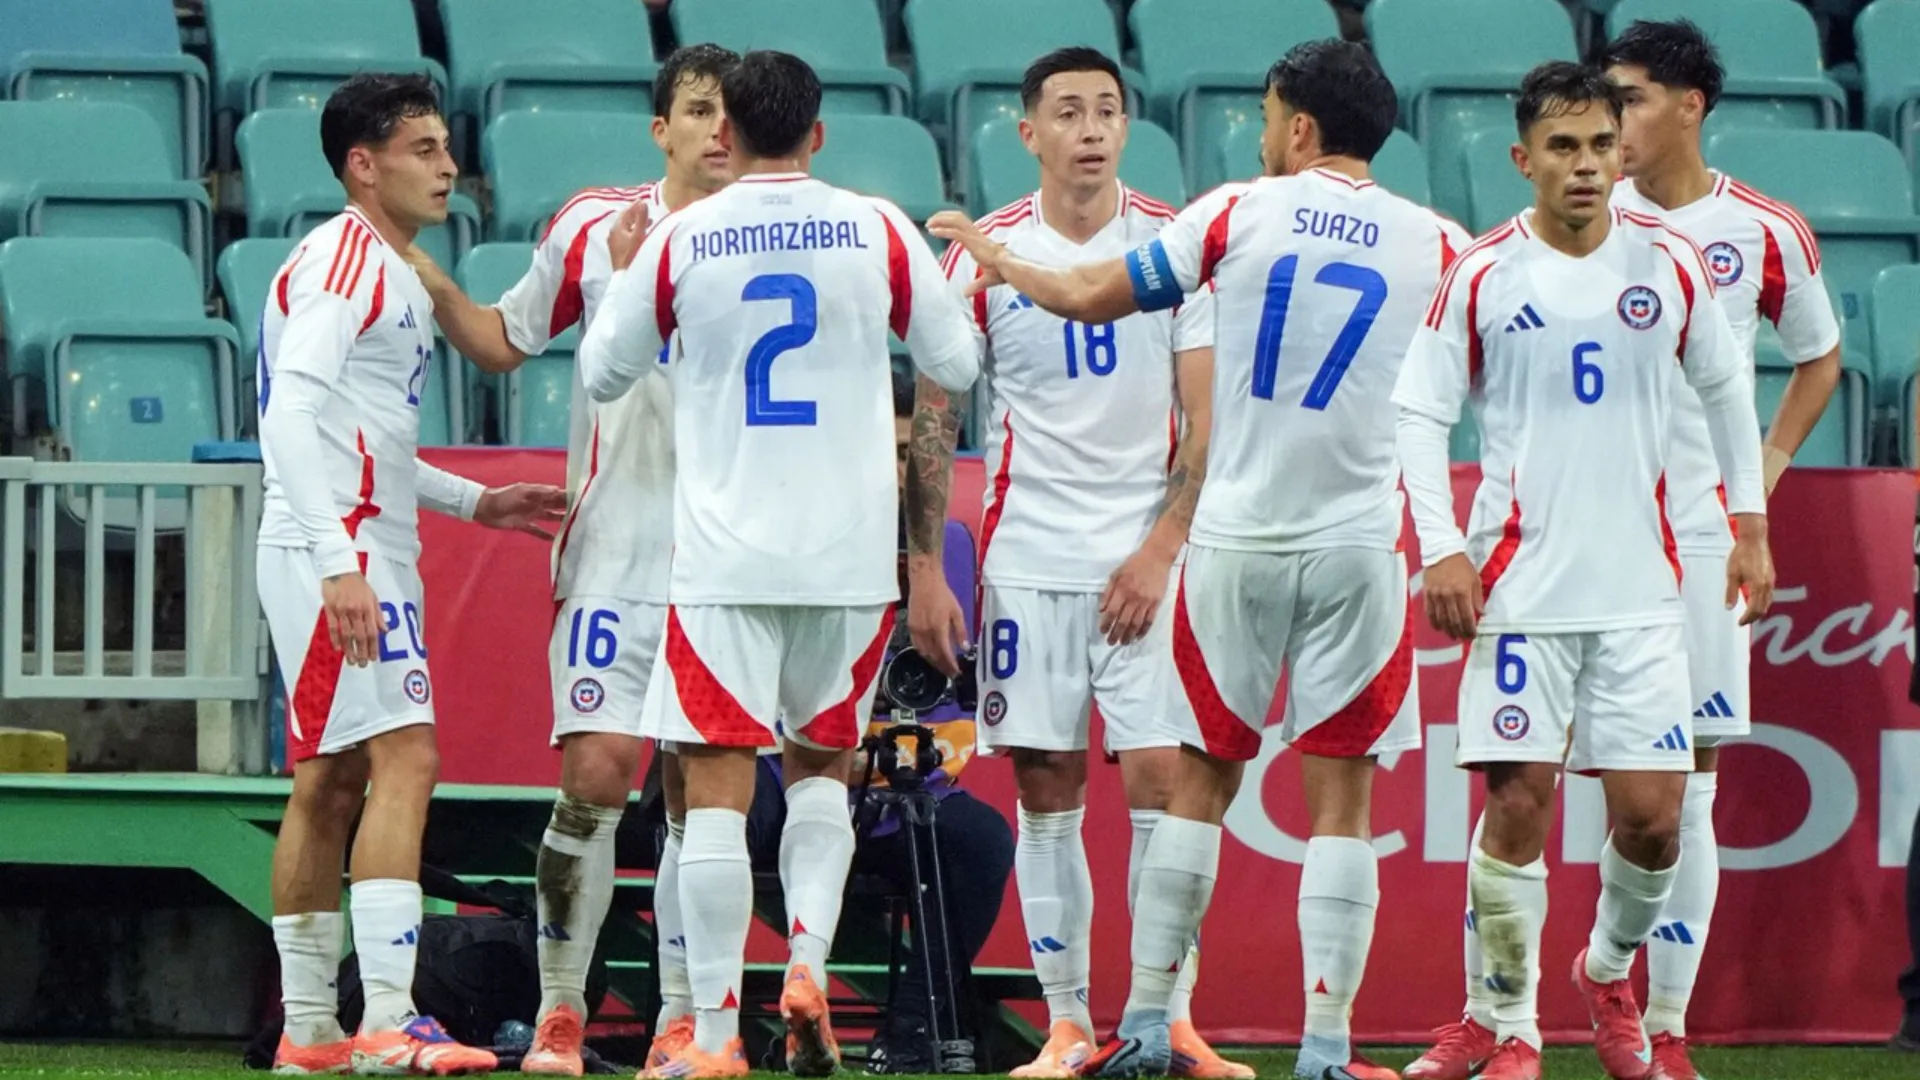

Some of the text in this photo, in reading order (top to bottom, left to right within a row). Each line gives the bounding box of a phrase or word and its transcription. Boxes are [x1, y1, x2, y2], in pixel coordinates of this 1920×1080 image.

[692, 215, 867, 260] HORMAZÁBAL
[1293, 207, 1379, 248] SUAZO
[740, 273, 818, 427] 2
[1064, 319, 1117, 379] 18
[1250, 253, 1389, 411] 17
[1572, 341, 1604, 405] 6
[141, 400, 155, 419] 2
[378, 601, 427, 663] 20
[567, 608, 620, 669] 16
[981, 618, 1019, 682] 18
[1494, 634, 1527, 695] 6
